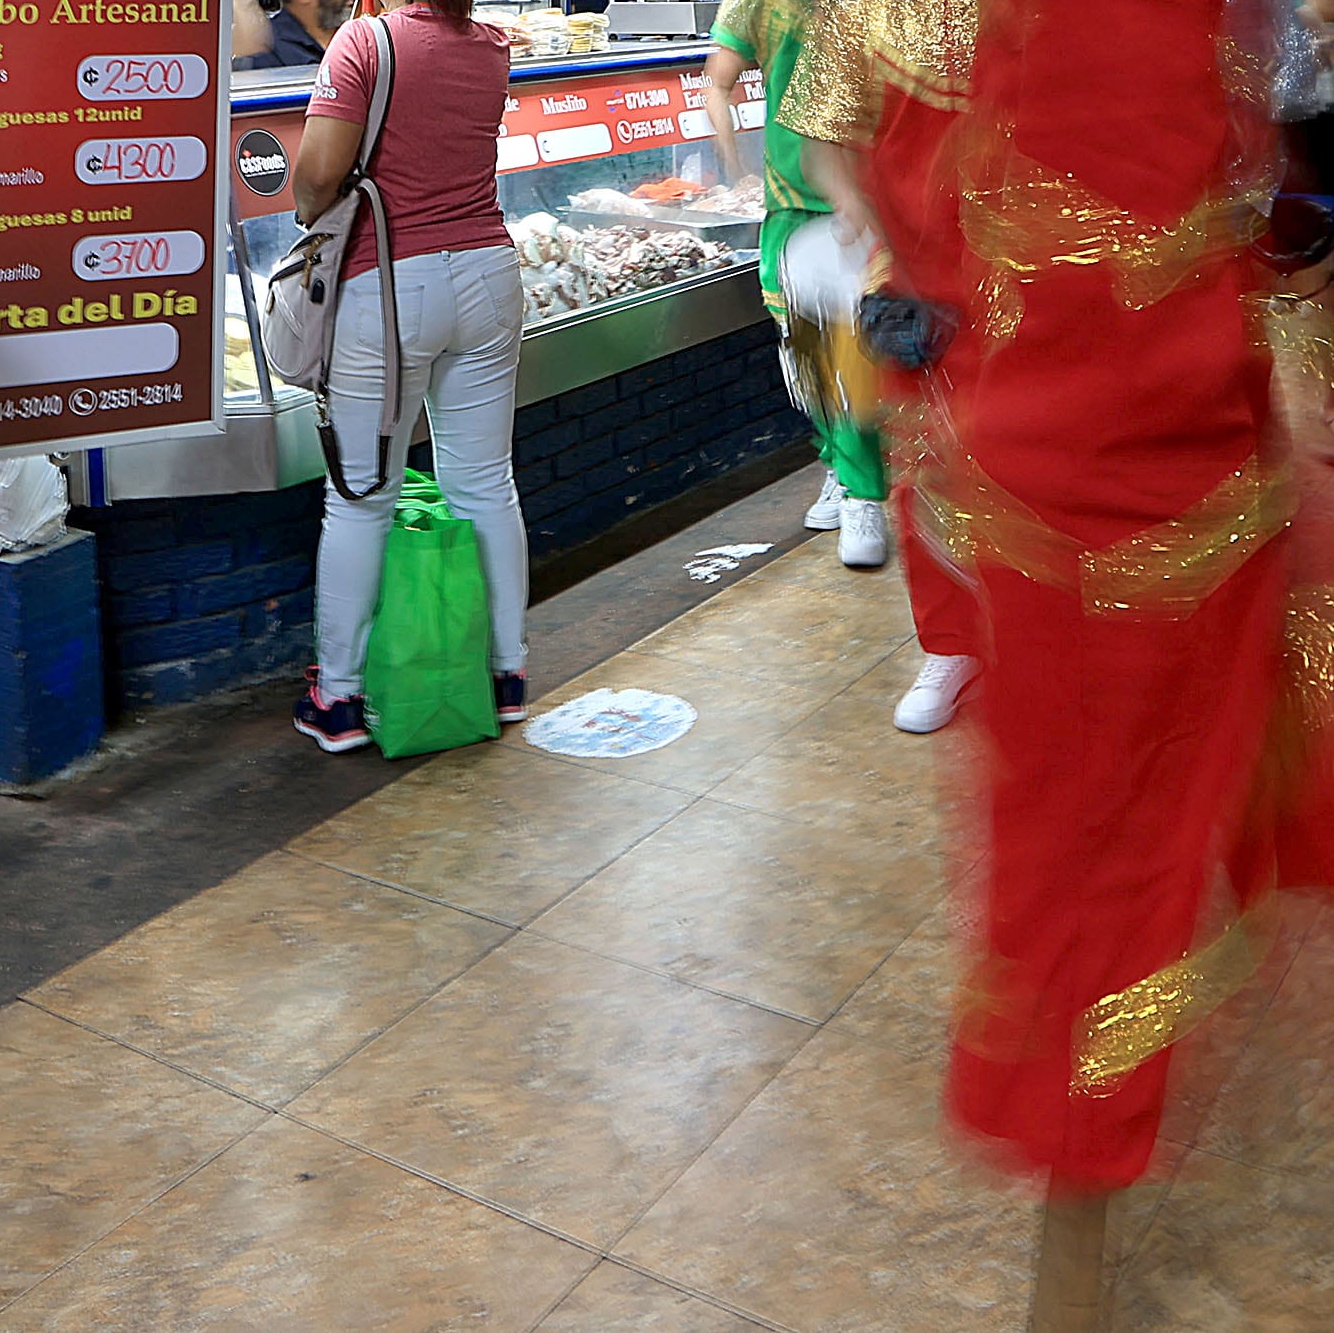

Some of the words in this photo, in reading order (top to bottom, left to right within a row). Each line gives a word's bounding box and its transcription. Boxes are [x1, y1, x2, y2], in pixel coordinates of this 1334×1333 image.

[73, 106, 143, 124] 12unid
[541, 94, 588, 115] Muslito
[70, 208, 85, 223] 8
[87, 206, 133, 222] unid
[57, 295, 125, 326] del
[131, 289, 198, 320] Día
[98, 383, 183, 410] 2551-2814
